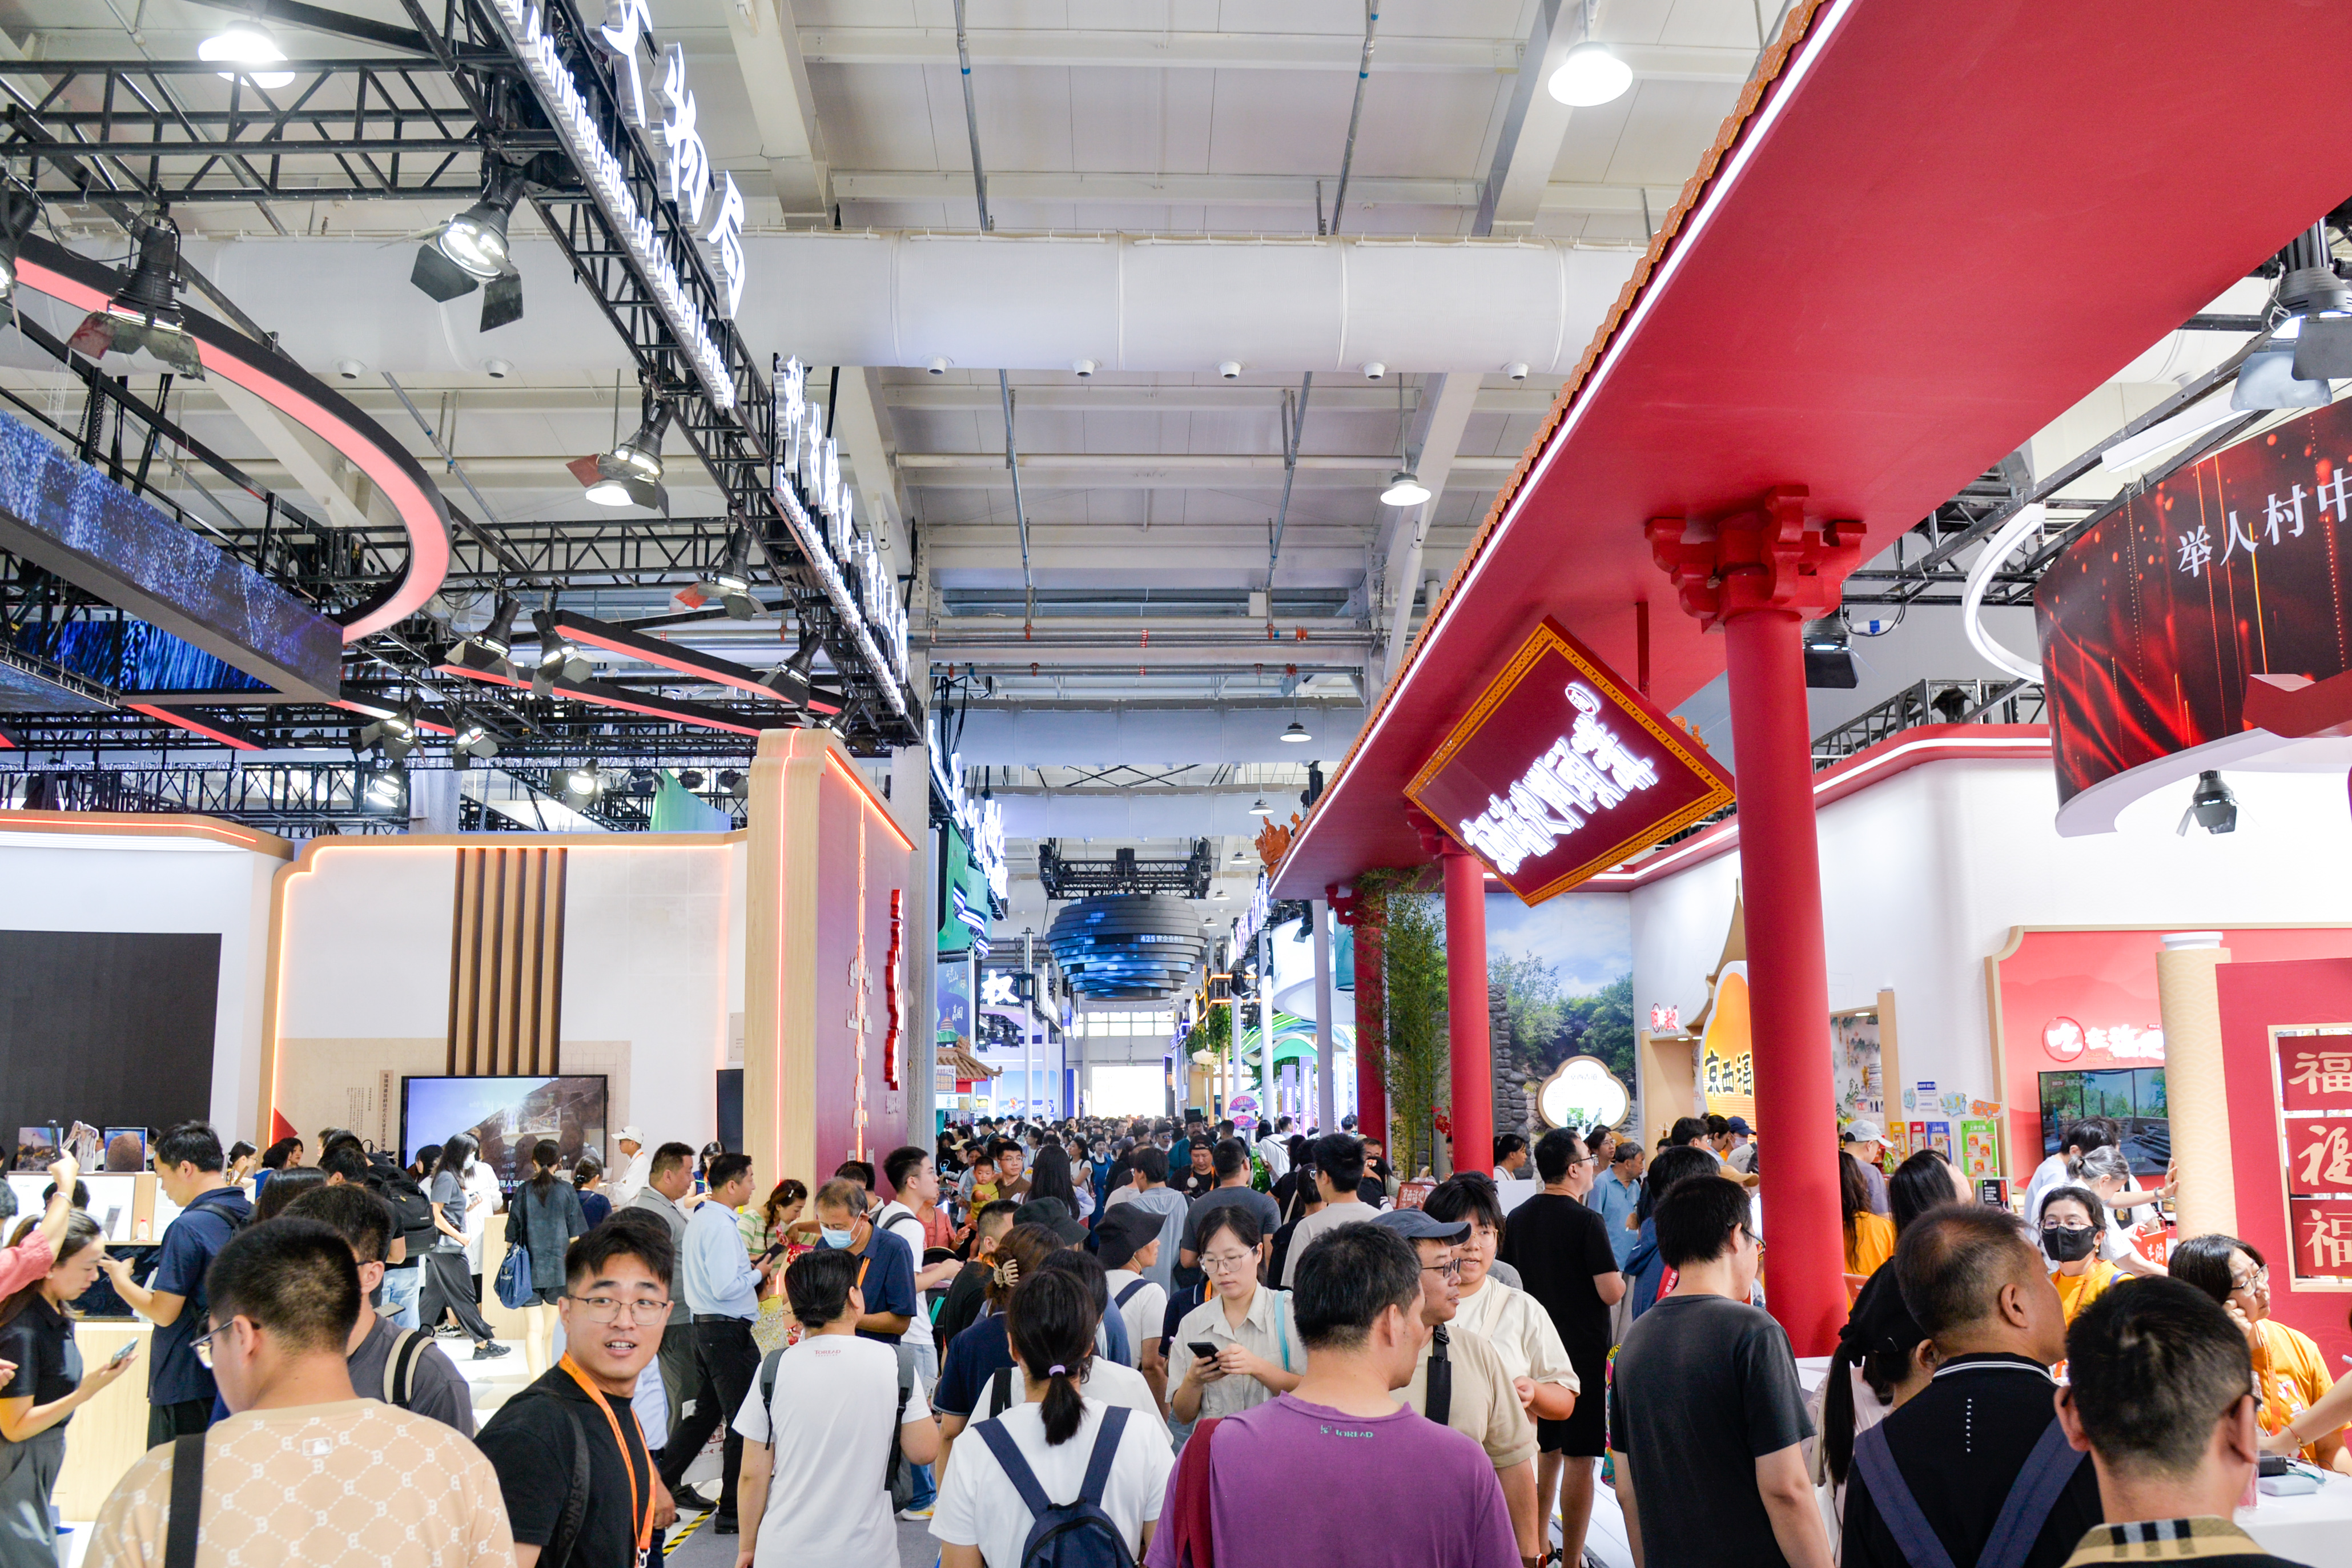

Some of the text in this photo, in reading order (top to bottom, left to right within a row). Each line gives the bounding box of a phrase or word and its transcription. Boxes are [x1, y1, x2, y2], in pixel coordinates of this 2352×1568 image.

[526, 5, 735, 409] Administration of Cultural Heritage
[2177, 467, 2352, 578] 举人村中
[982, 969, 1020, 1007] 权
[1705, 1050, 1752, 1097] 京西福
[2288, 1052, 2352, 1095] 福
[2302, 1208, 2352, 1268] 福
[1335, 1429, 1374, 1438] TOREAD
